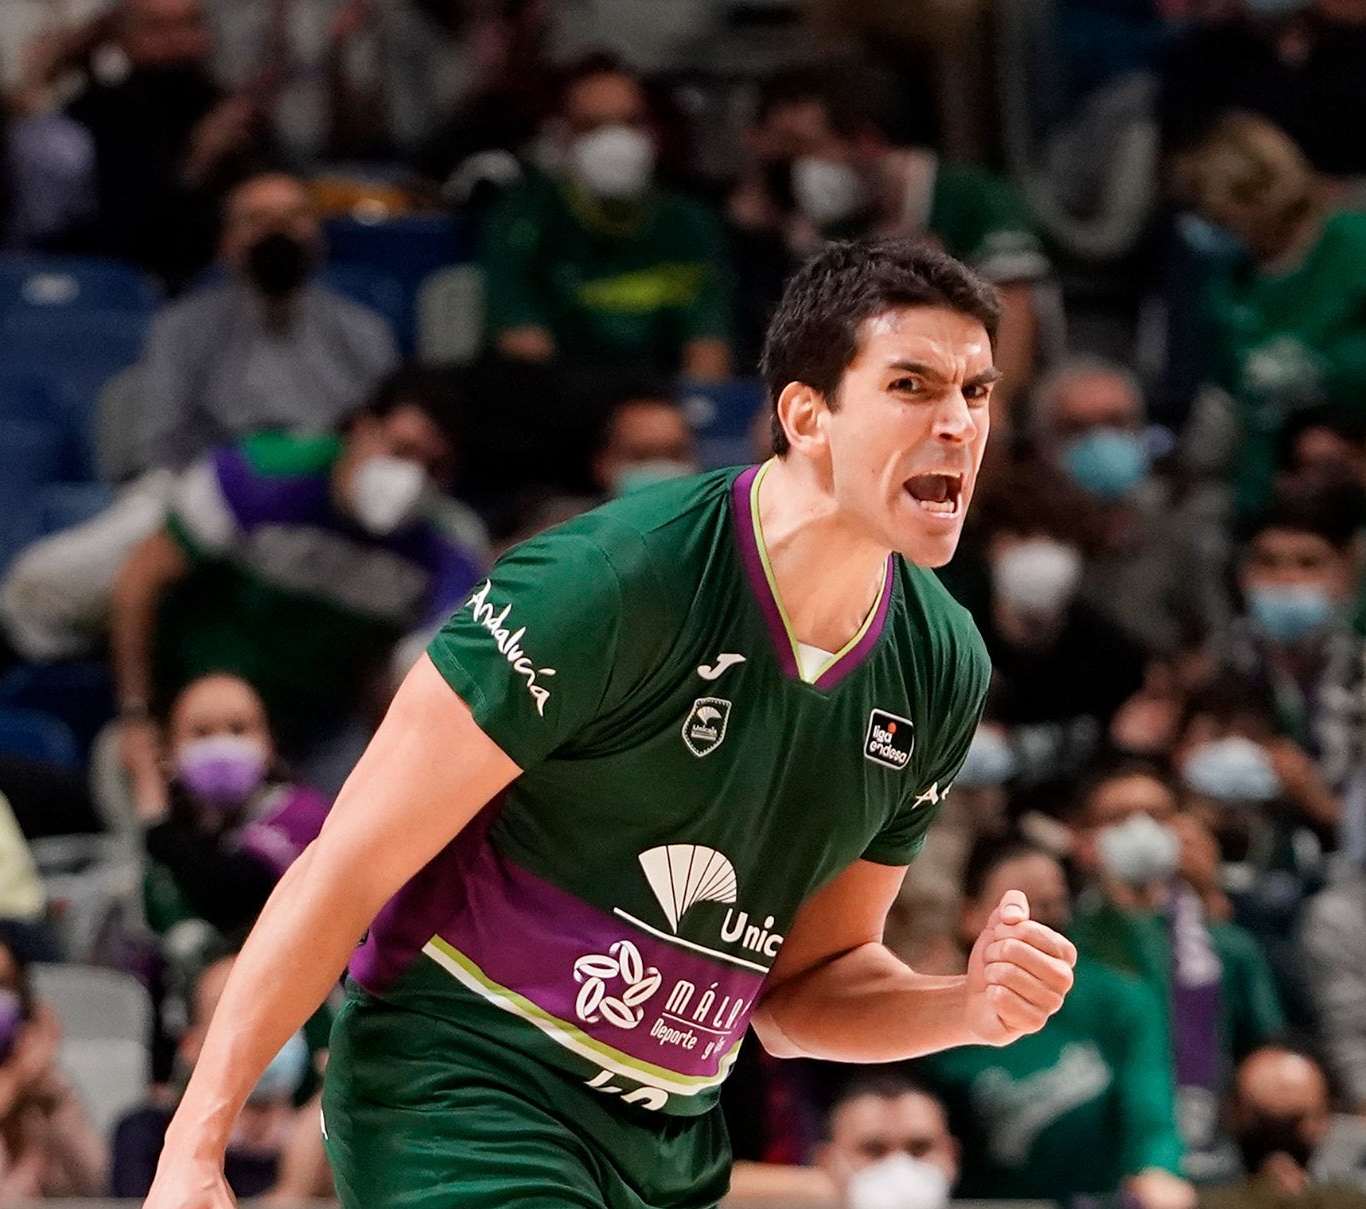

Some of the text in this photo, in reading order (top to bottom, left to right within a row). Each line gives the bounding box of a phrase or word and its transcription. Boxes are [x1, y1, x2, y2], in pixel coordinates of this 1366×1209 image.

[465, 578, 557, 717] Andalucía
[872, 725, 893, 743] liga
[869, 741, 908, 763] endesa
[650, 1018, 698, 1050] Deporte
